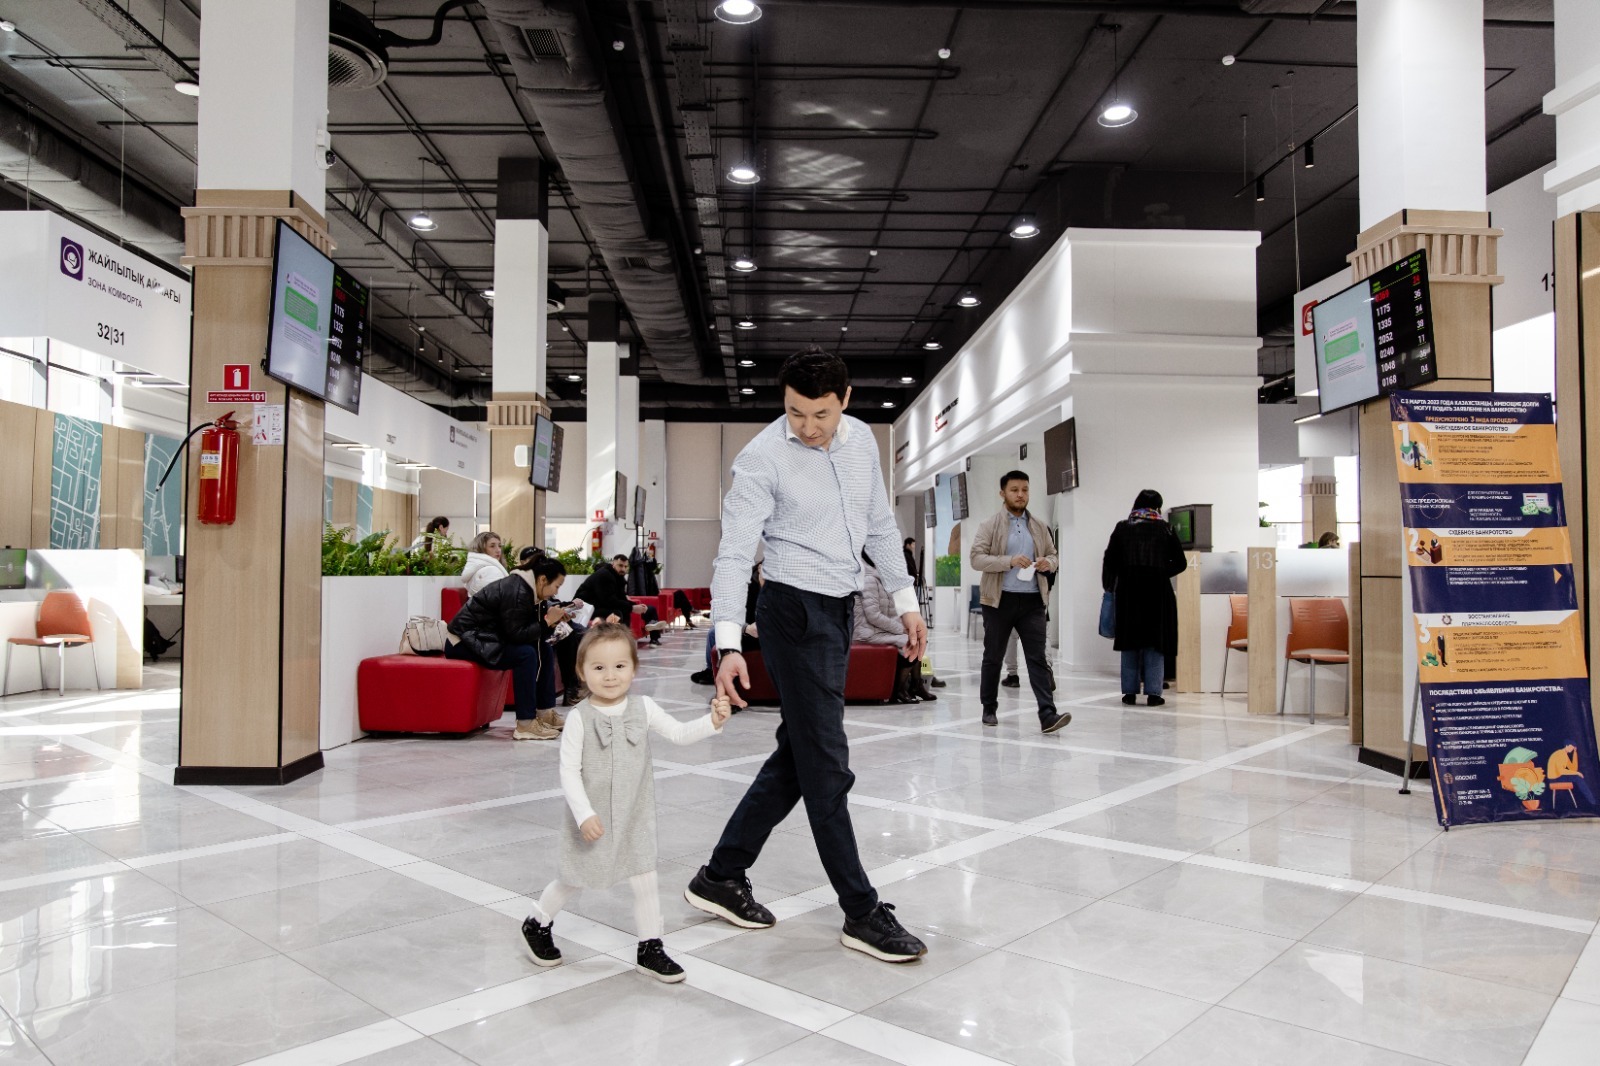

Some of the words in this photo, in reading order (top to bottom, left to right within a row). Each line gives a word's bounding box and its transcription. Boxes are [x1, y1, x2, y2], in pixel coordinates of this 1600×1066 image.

[88, 248, 145, 288] ЖАЙЛЫЛЫҚ
[1541, 272, 1555, 292] 1
[88, 276, 107, 293] ЗОНА
[108, 285, 143, 309] КОМФОРТА
[334, 303, 345, 318] 1175
[1376, 302, 1391, 317] 1175
[1377, 316, 1392, 331] 1335
[1378, 331, 1394, 346] 2052
[1379, 345, 1395, 360] 0240
[1381, 359, 1396, 373] 1048
[1382, 374, 1397, 387] 0168
[250, 393, 265, 401] 101
[1397, 422, 1410, 447] 1
[1408, 528, 1420, 553] 2
[1252, 551, 1273, 570] 13
[1429, 688, 1473, 696] ПОСЛЕДСТВИЯ
[1473, 687, 1515, 695] ОБЪЯВЛЕНИЯ
